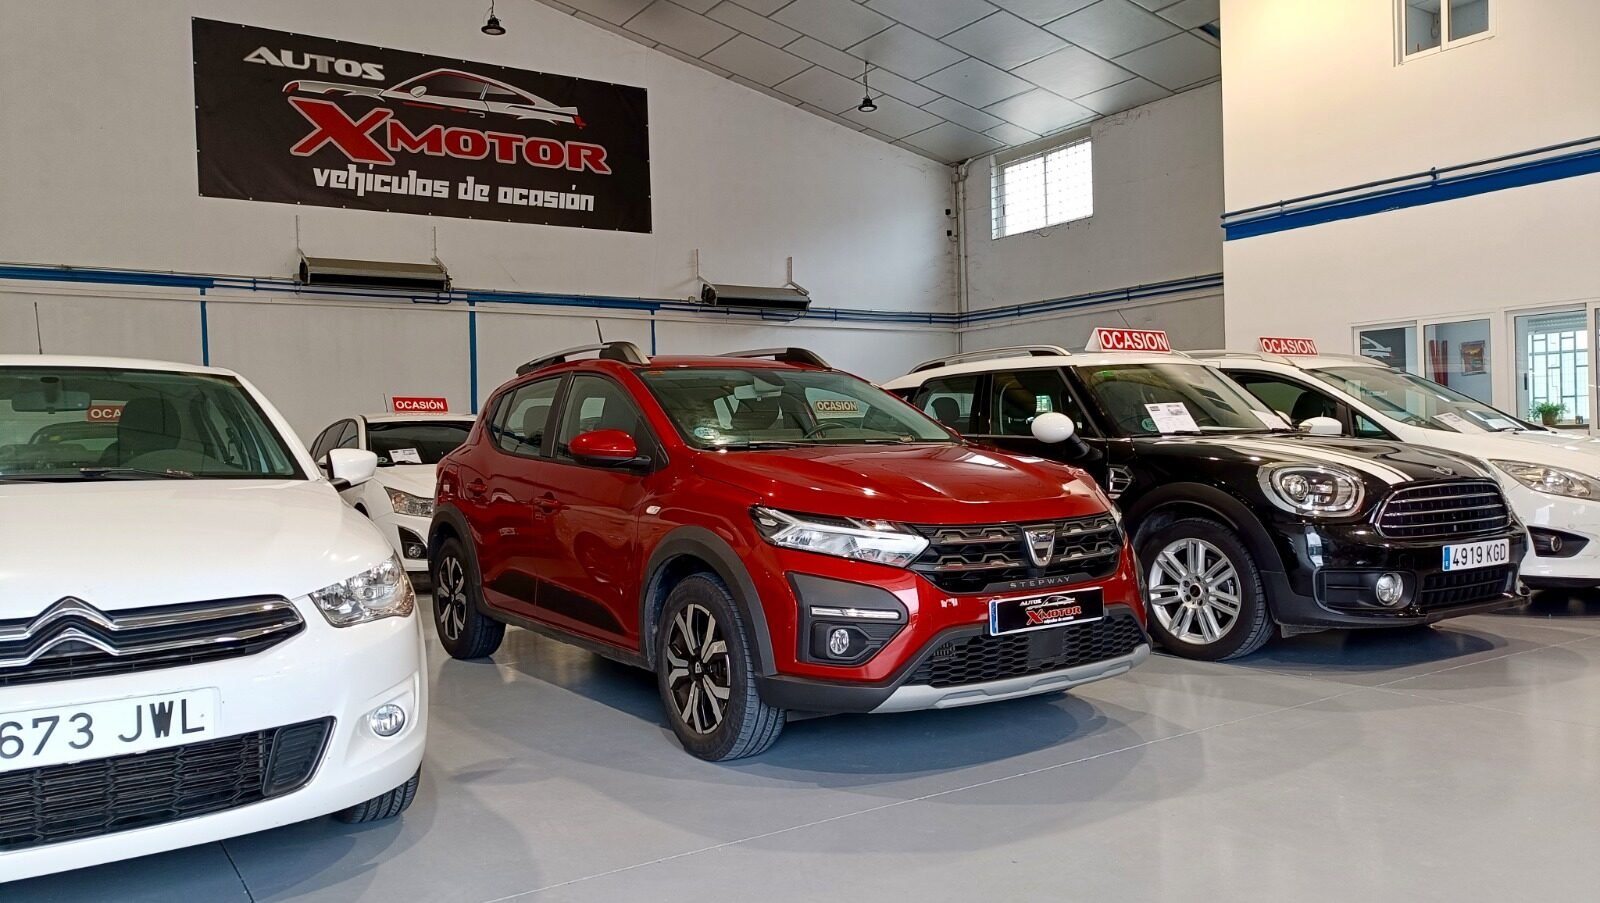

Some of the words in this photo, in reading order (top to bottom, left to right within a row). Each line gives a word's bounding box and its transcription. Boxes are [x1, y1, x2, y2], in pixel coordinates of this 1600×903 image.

[243, 46, 385, 81] AUTOS
[312, 163, 450, 199] vehículos
[458, 176, 490, 203] de
[497, 184, 594, 212] ocasión
[1100, 330, 1168, 350] OCASION
[1262, 338, 1317, 354] OCASION
[395, 399, 445, 409] OCASIÓN
[1452, 546, 1483, 567] 4919
[1486, 543, 1506, 563] KGD
[1009, 575, 1070, 588] STEPWAY
[0, 711, 95, 760] 673
[117, 698, 206, 743] JWL
